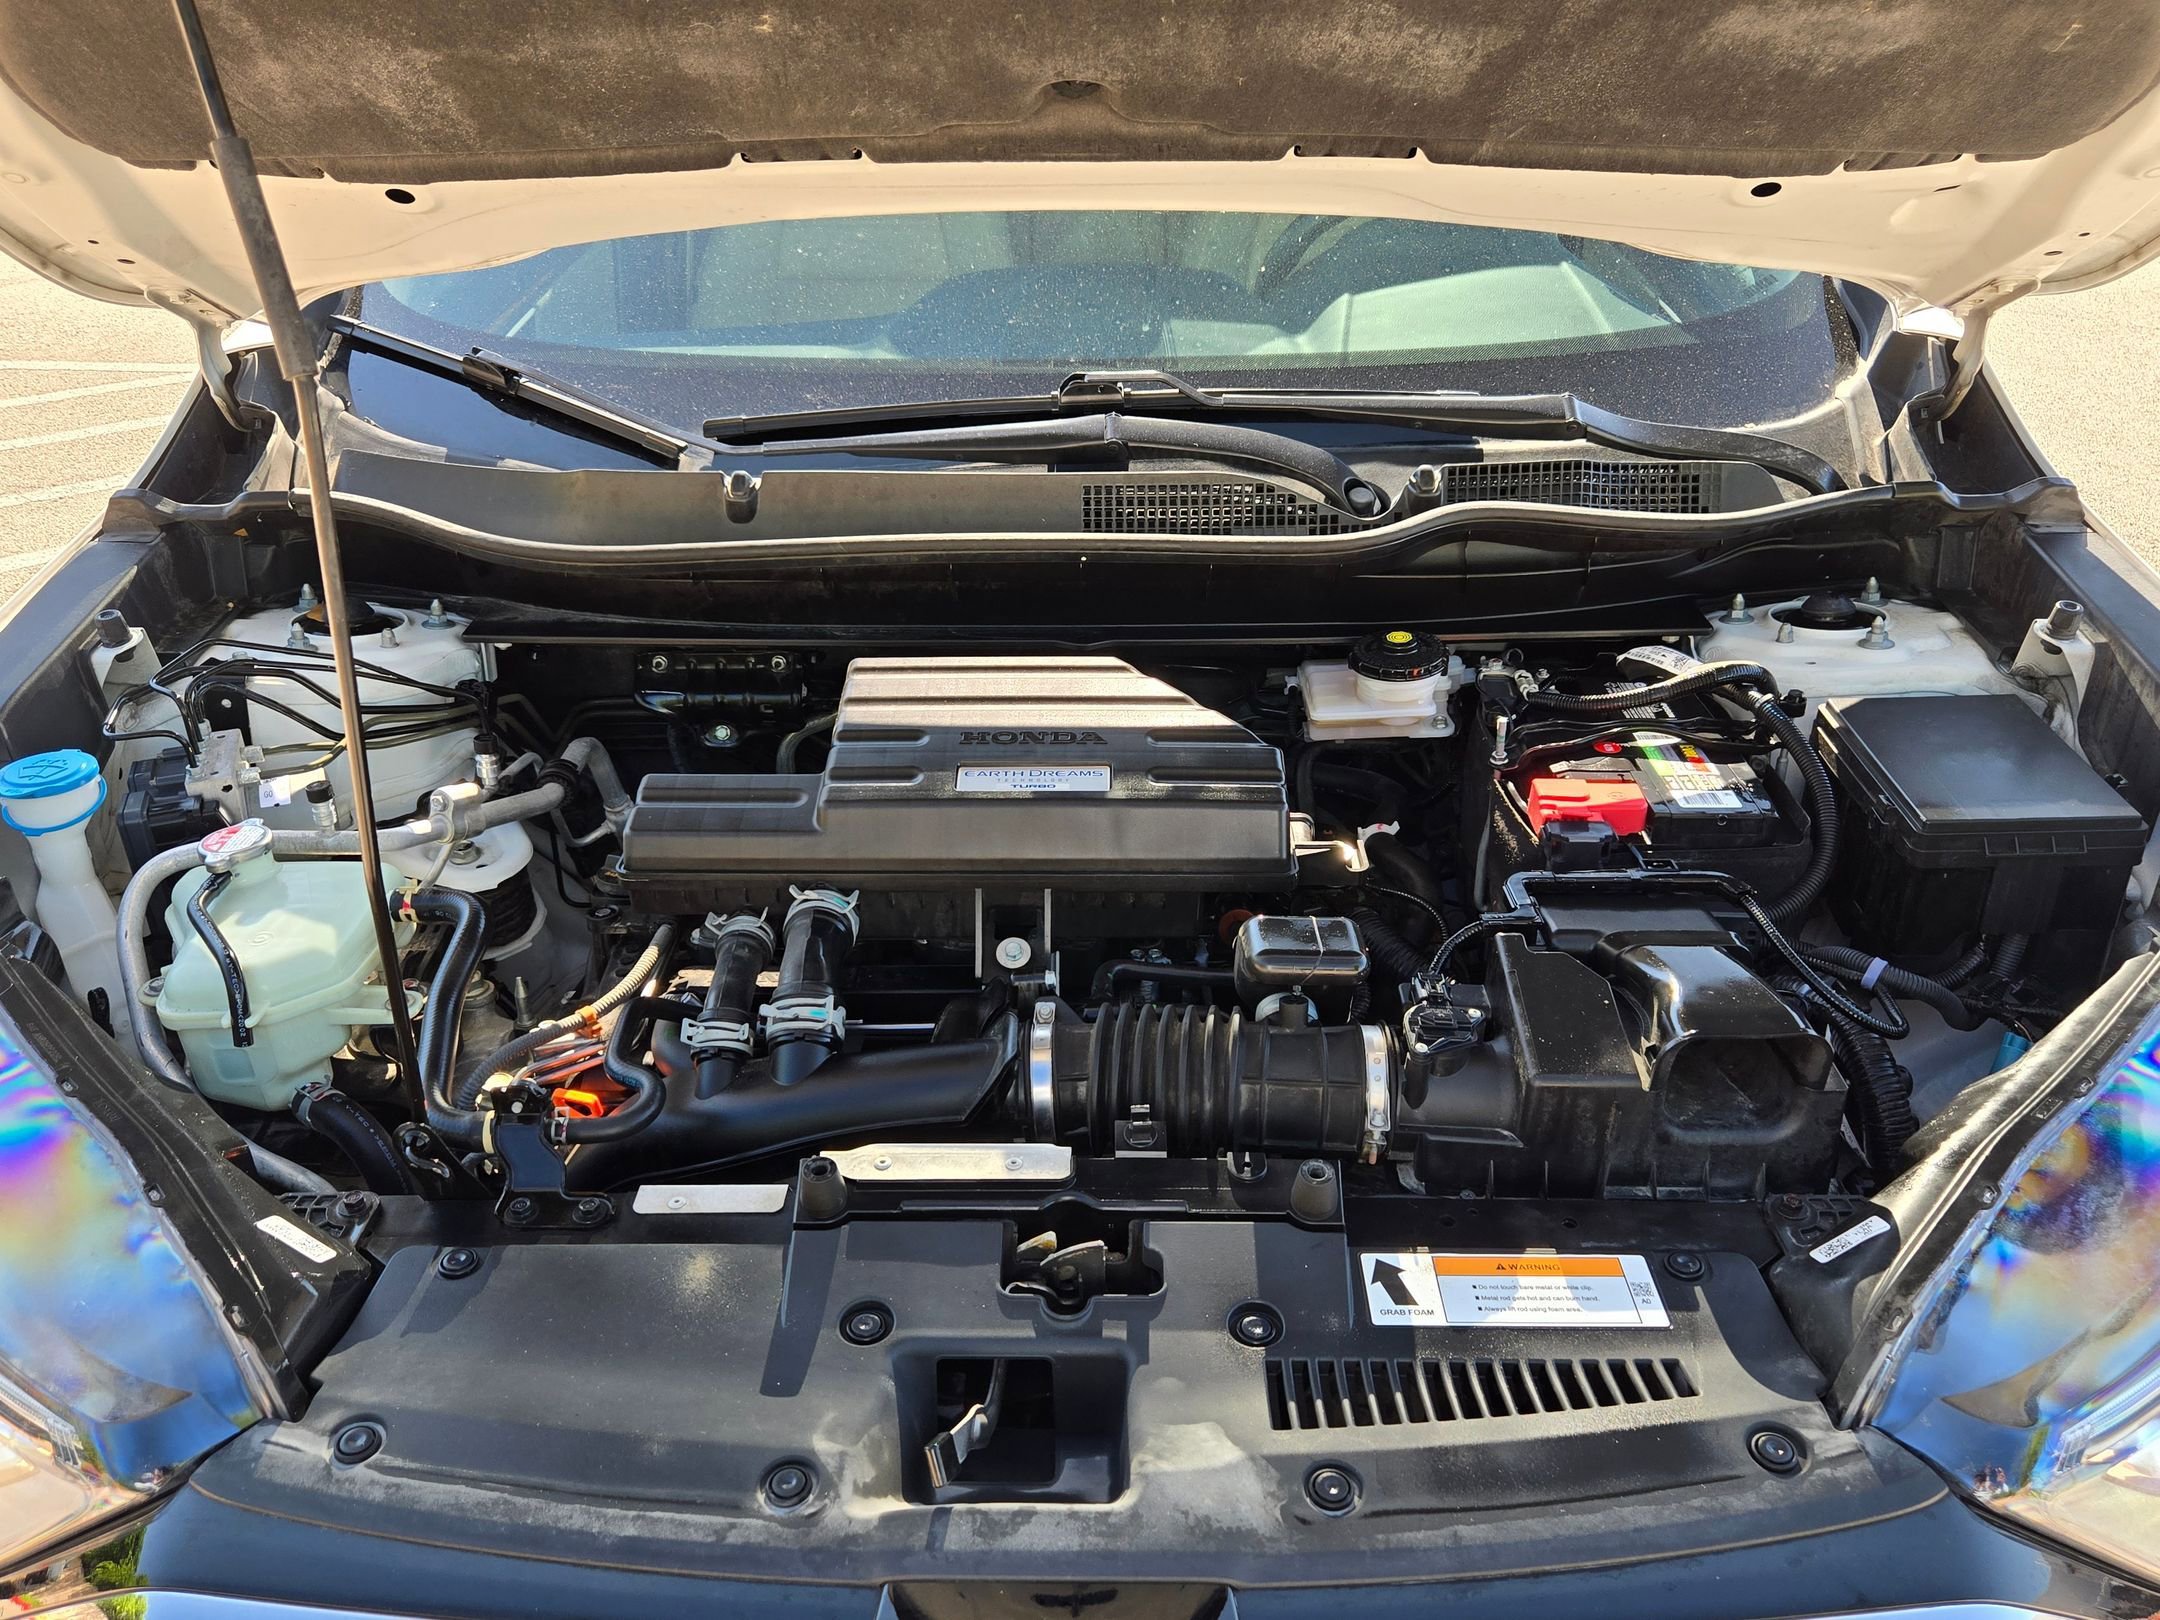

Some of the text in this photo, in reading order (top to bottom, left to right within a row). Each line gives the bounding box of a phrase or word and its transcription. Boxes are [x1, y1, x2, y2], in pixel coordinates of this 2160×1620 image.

[959, 731, 1108, 745] HONDA
[1029, 769, 1104, 777] DREAMS
[1507, 1263, 1561, 1271] WARNING
